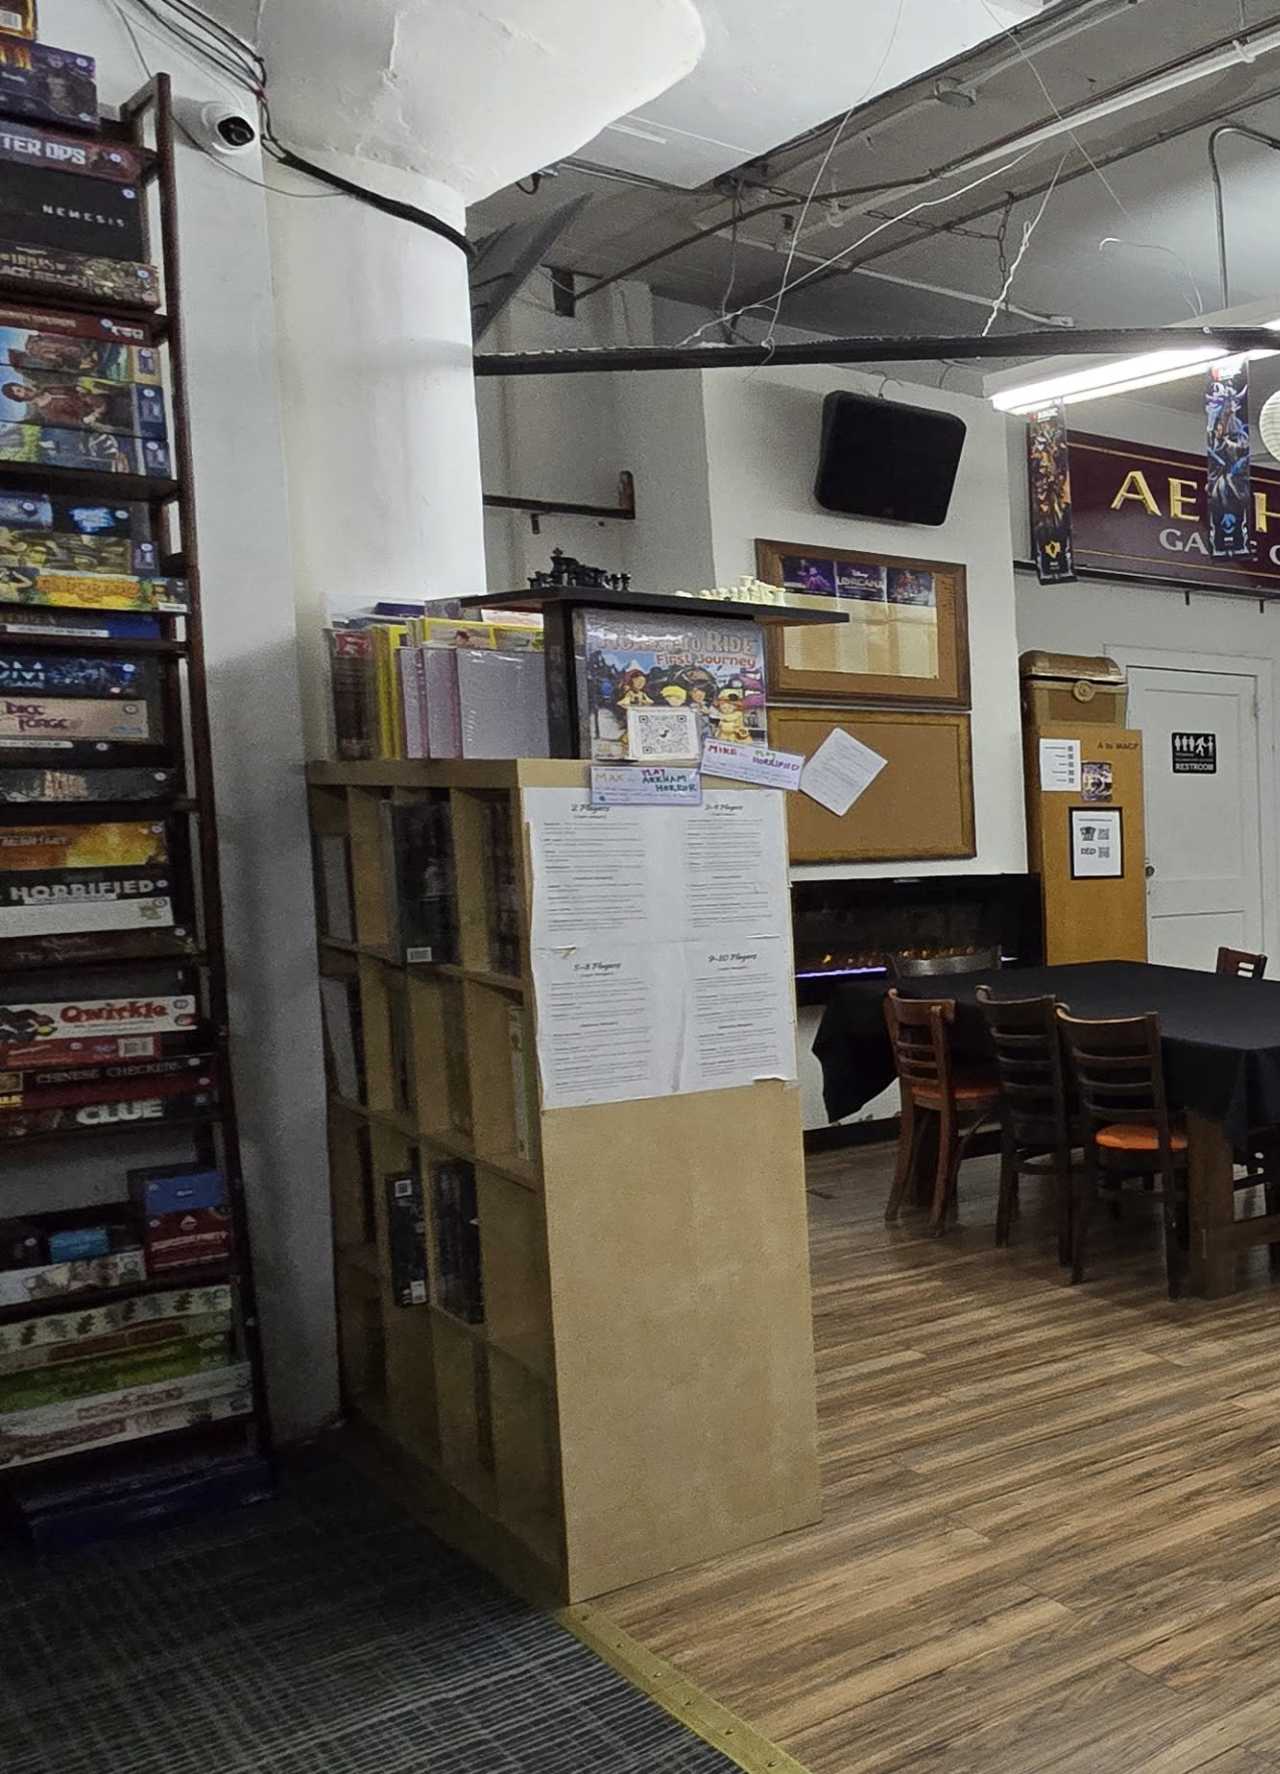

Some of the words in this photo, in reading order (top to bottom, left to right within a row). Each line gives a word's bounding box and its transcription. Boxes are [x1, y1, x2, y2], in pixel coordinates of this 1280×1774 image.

[46, 142, 86, 165] OPS
[42, 204, 125, 227] NEMESIS
[709, 631, 755, 654] RIDE
[656, 653, 692, 666] First
[698, 654, 756, 668] Journey
[708, 745, 736, 755] MIKE
[1175, 763, 1214, 771] RESTROOM
[10, 880, 154, 901] HORRIFIED
[76, 1098, 164, 1125] CLUE
